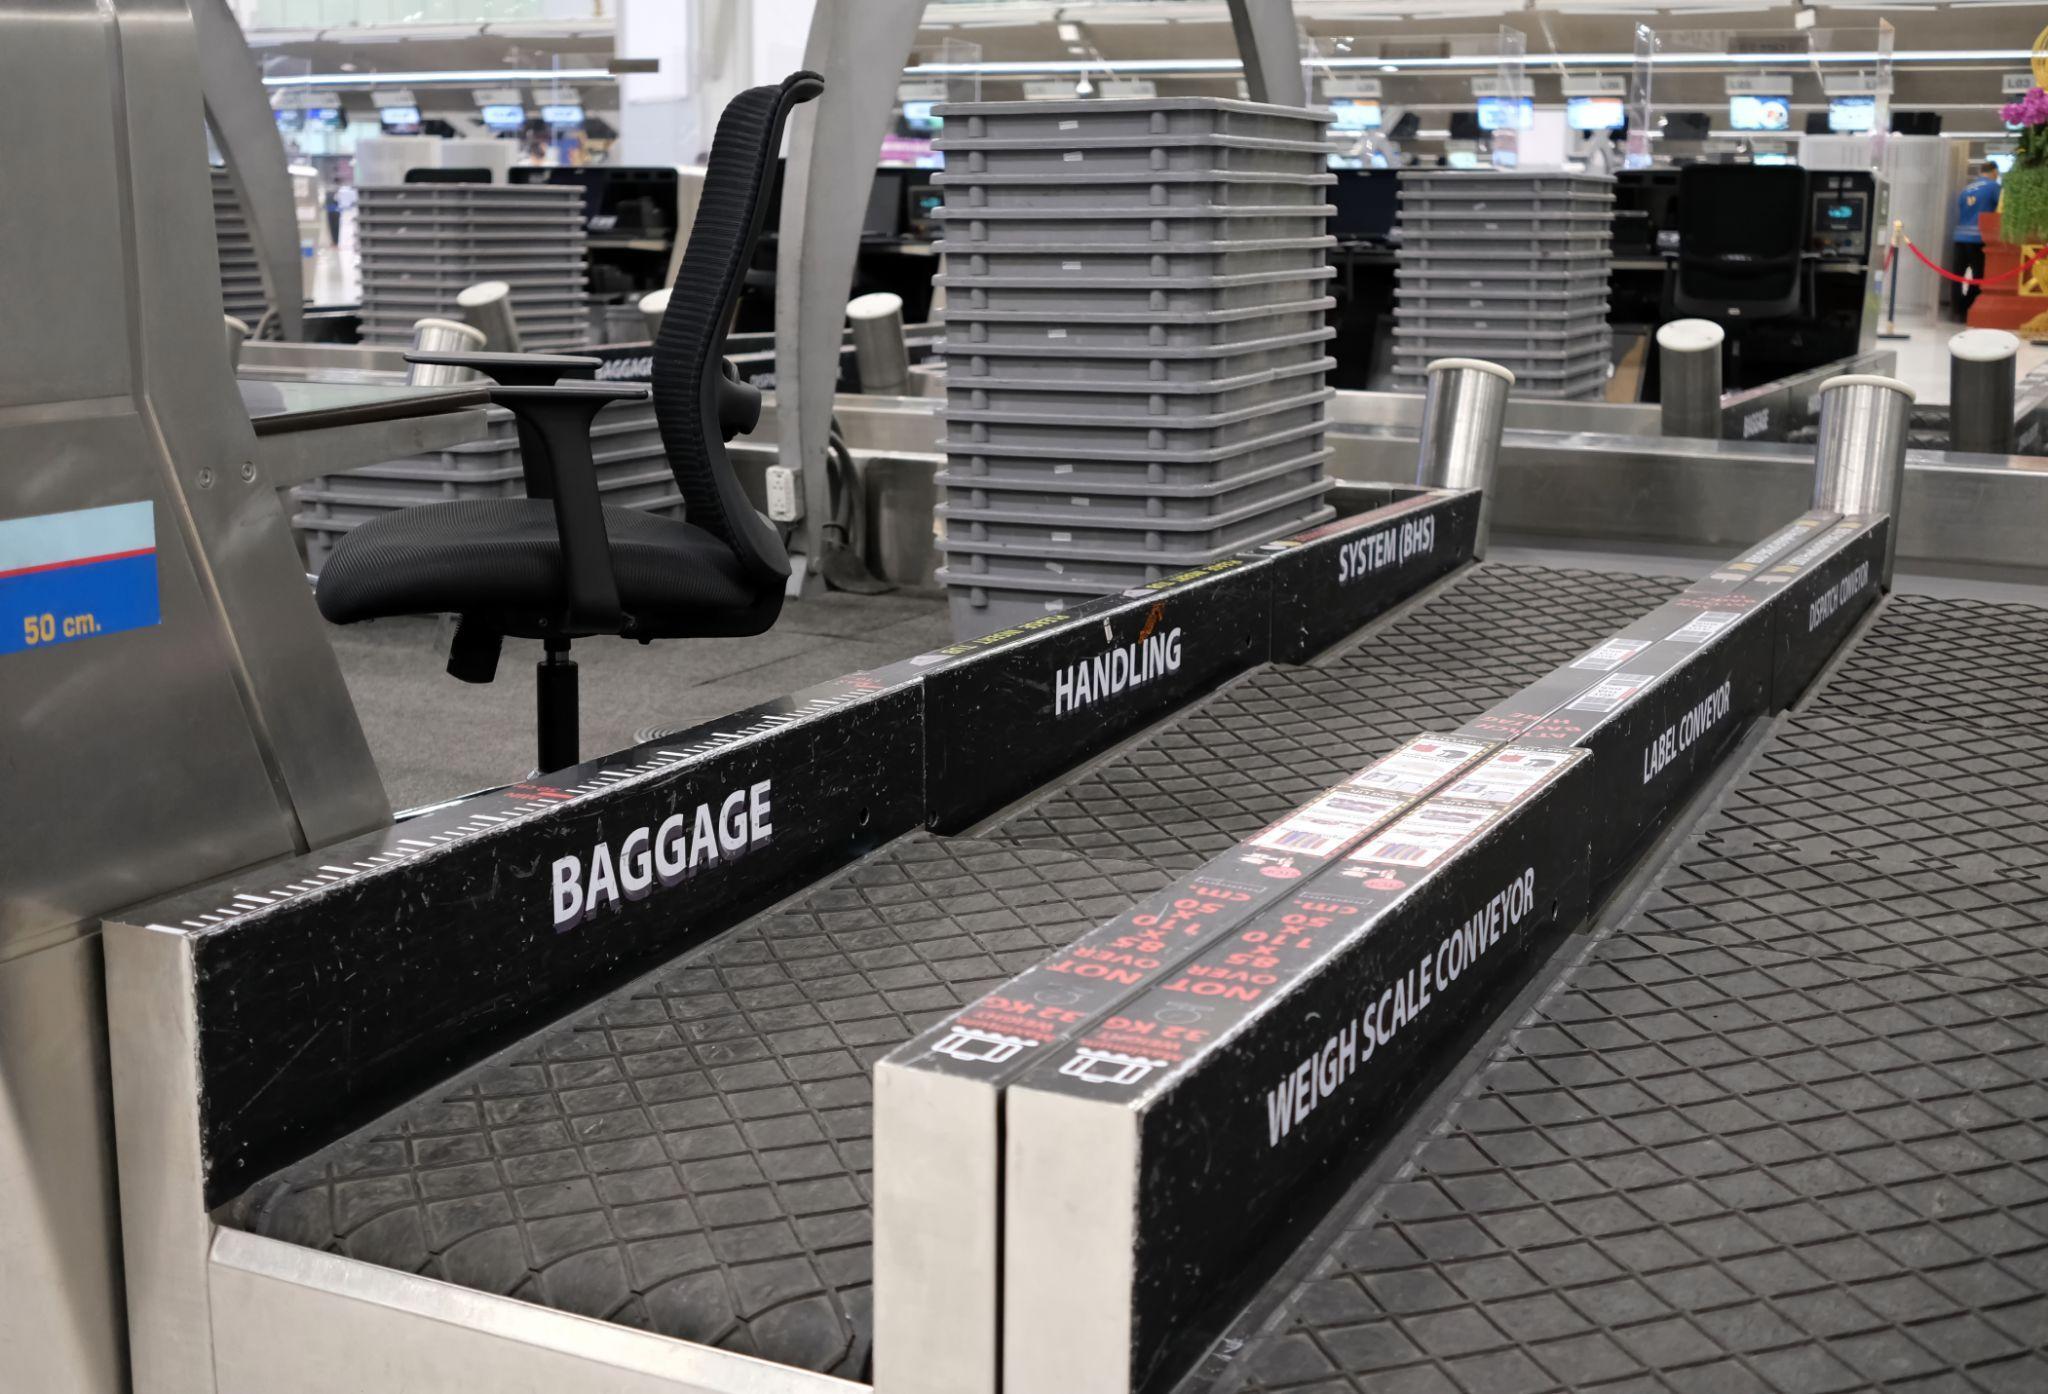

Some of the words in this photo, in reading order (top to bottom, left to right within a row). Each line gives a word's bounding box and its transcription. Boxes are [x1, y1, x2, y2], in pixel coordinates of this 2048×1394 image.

[1338, 527, 1396, 583] SYSTEM
[1398, 514, 1435, 567] (BHS)
[1809, 586, 1839, 632] DISPATCH
[1839, 560, 1869, 608] CONVEYOR
[24, 613, 55, 645] 50
[63, 613, 101, 637] cm.
[1055, 627, 1182, 716] HANDLING
[1643, 724, 1678, 784] LABEL
[1679, 681, 1731, 752] CONVEYOR
[552, 779, 773, 928] BAGGAGE
[1189, 885, 1251, 901] cm.
[1174, 899, 1225, 914] 50
[1294, 900, 1358, 914] cm.
[1132, 914, 1202, 936] 110
[1281, 914, 1333, 928] 50
[1112, 936, 1165, 952] 85
[1241, 930, 1313, 949] 110
[1074, 947, 1161, 969] OVER
[1224, 953, 1280, 969] 85
[1046, 963, 1143, 985] NOT
[1188, 965, 1277, 985] OVER
[1162, 981, 1261, 1001] NOT
[981, 996, 1035, 1015] KG
[1037, 1006, 1086, 1023] 32
[1268, 1019, 1357, 1147] WEIGH
[1362, 954, 1432, 1062] SCALE
[1436, 867, 1535, 992] CONVEYOR
[1101, 1015, 1157, 1036] KG
[1160, 1025, 1210, 1042] 32
